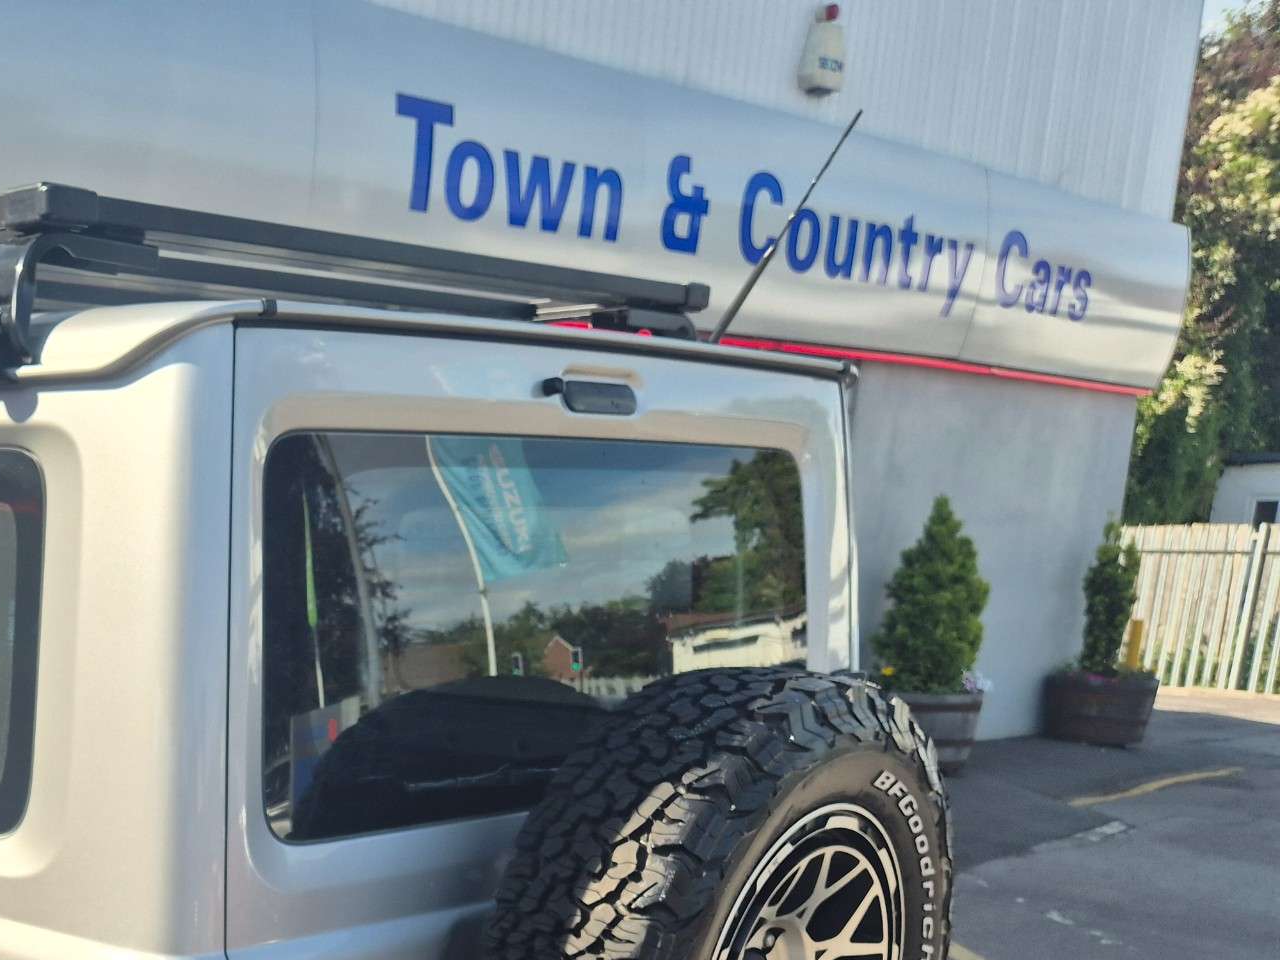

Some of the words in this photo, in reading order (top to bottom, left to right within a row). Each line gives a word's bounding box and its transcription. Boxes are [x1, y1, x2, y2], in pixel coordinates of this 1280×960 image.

[395, 92, 622, 242] Town
[661, 154, 709, 256] &
[738, 169, 976, 319] Country
[995, 229, 1092, 322] Cars
